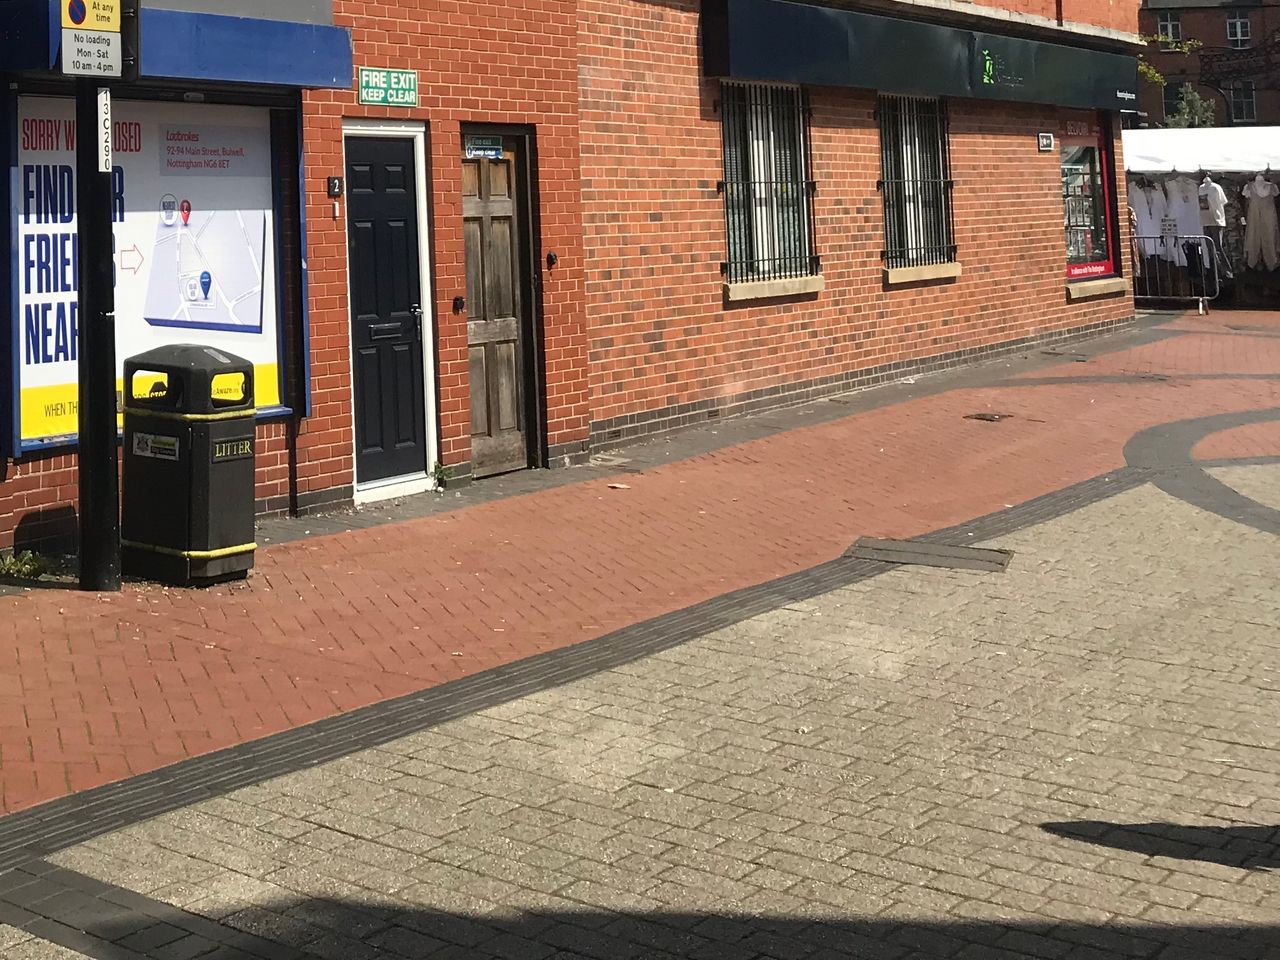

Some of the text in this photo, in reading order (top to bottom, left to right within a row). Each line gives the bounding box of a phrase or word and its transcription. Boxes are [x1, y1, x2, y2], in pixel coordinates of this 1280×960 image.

[92, 1, 114, 13] At any
[96, 13, 111, 23] time
[74, 33, 111, 47] No loading
[76, 48, 91, 57] Mon
[96, 49, 109, 59] Sat
[72, 60, 80, 70] 10
[81, 63, 92, 71] am
[96, 62, 102, 71] 4
[103, 64, 114, 73] pm
[361, 71, 416, 89] FIRE EXIT
[361, 89, 416, 103] KEEP CLEAR
[23, 118, 61, 151] SORRY
[111, 121, 142, 152] OSED
[334, 179, 339, 192] 2
[23, 164, 74, 225] FIND
[44, 401, 78, 418] WHEN TH
[215, 441, 252, 457] LITTER
